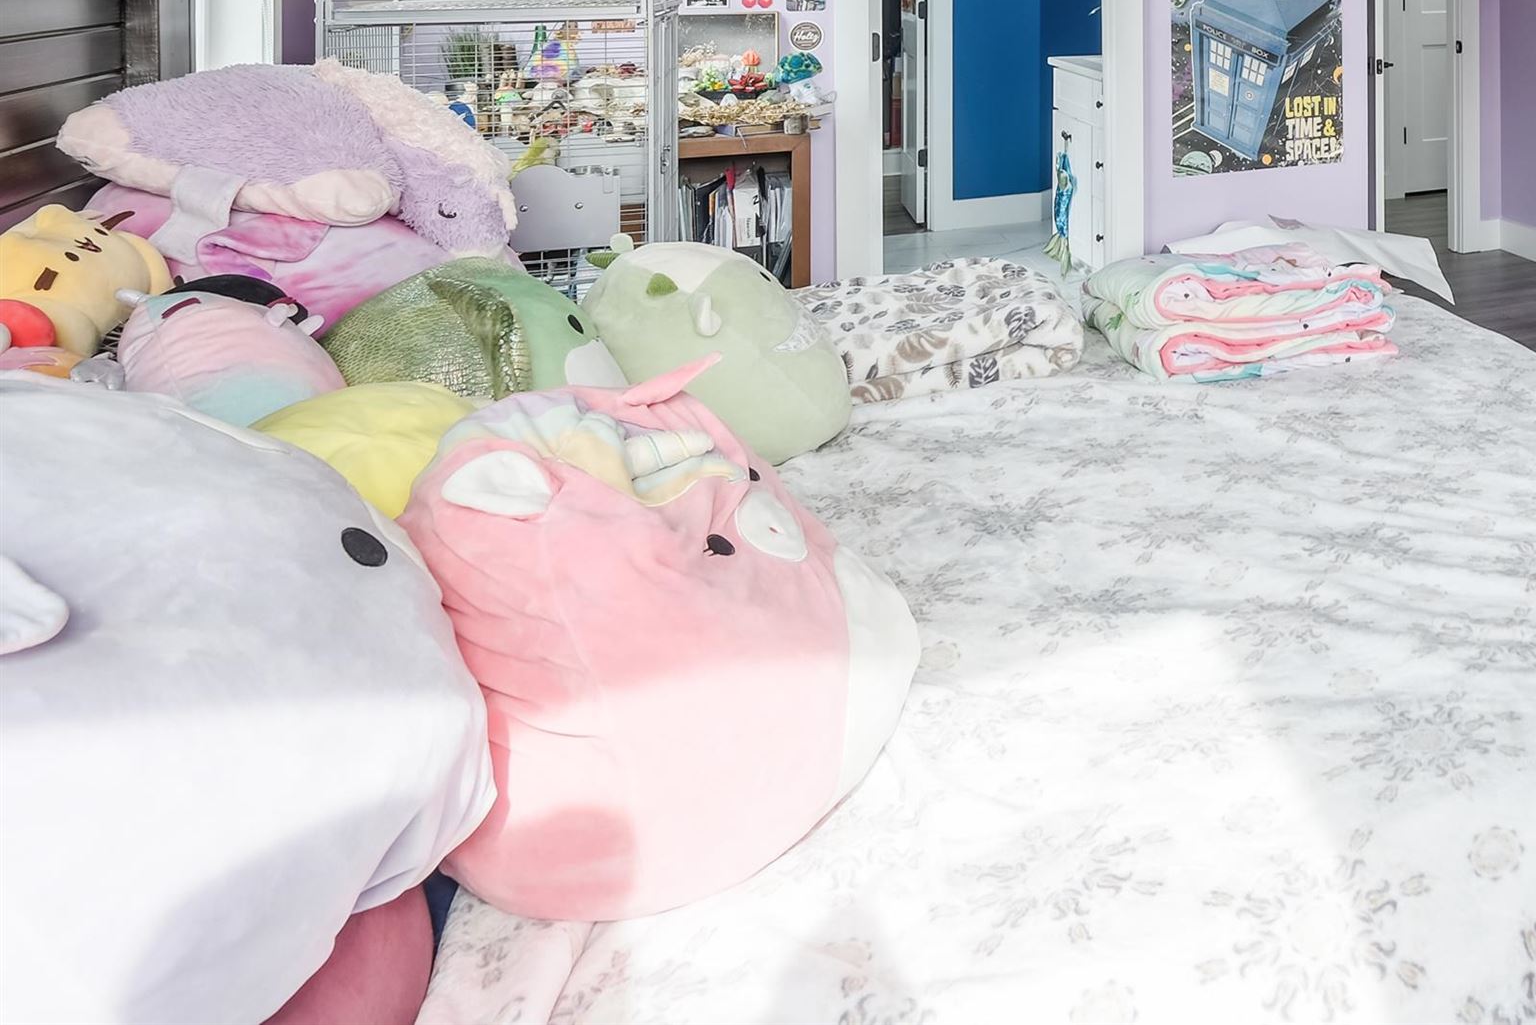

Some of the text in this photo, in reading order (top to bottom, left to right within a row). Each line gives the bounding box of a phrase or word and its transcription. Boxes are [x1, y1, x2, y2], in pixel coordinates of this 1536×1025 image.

[1202, 24, 1270, 59] POLICE BOX
[1285, 95, 1337, 118] LOST IN
[1285, 117, 1336, 140] TIME &
